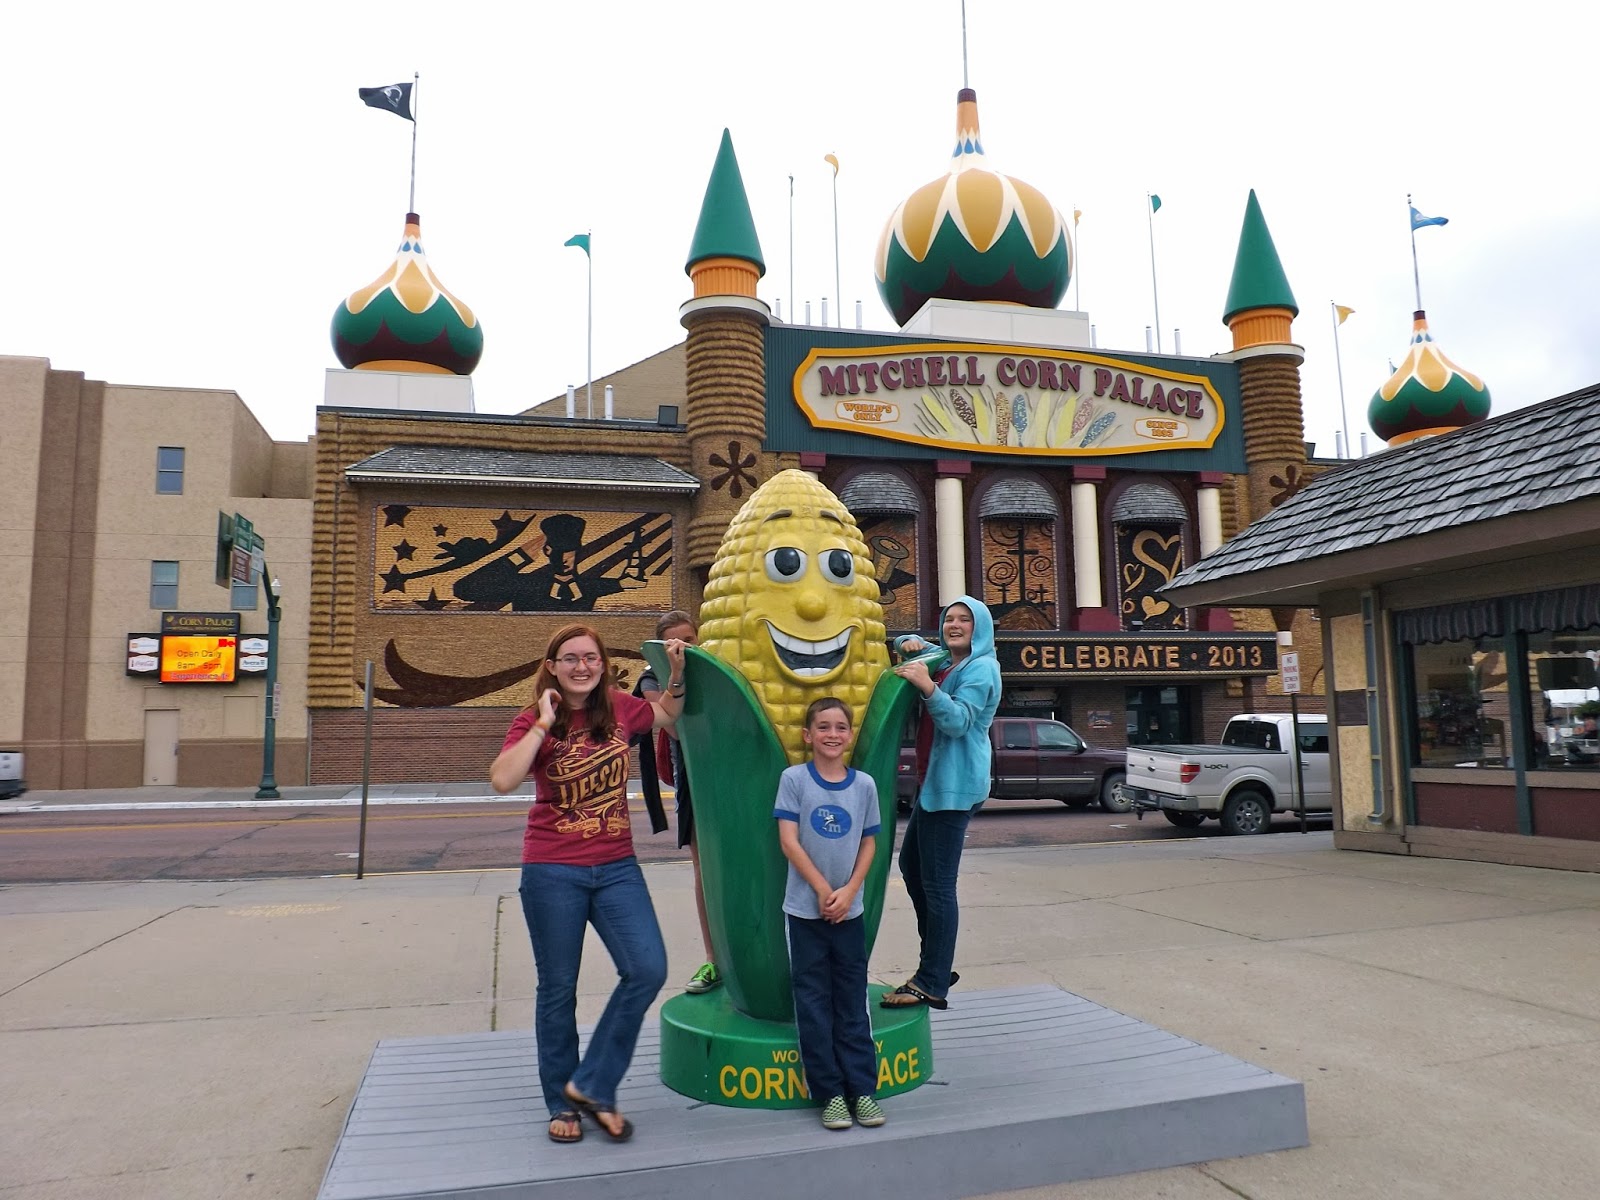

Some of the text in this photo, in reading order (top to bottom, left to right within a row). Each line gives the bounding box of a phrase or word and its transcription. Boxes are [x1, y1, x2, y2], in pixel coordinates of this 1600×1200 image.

[818, 356, 1204, 419] MITCHELL CORN PALACE
[843, 402, 892, 414] WORLD'S
[853, 411, 882, 421] ONLY
[1146, 420, 1178, 430] SINCE
[177, 649, 222, 659] Open Daily
[1020, 645, 1262, 669] CELEBRATE 2013
